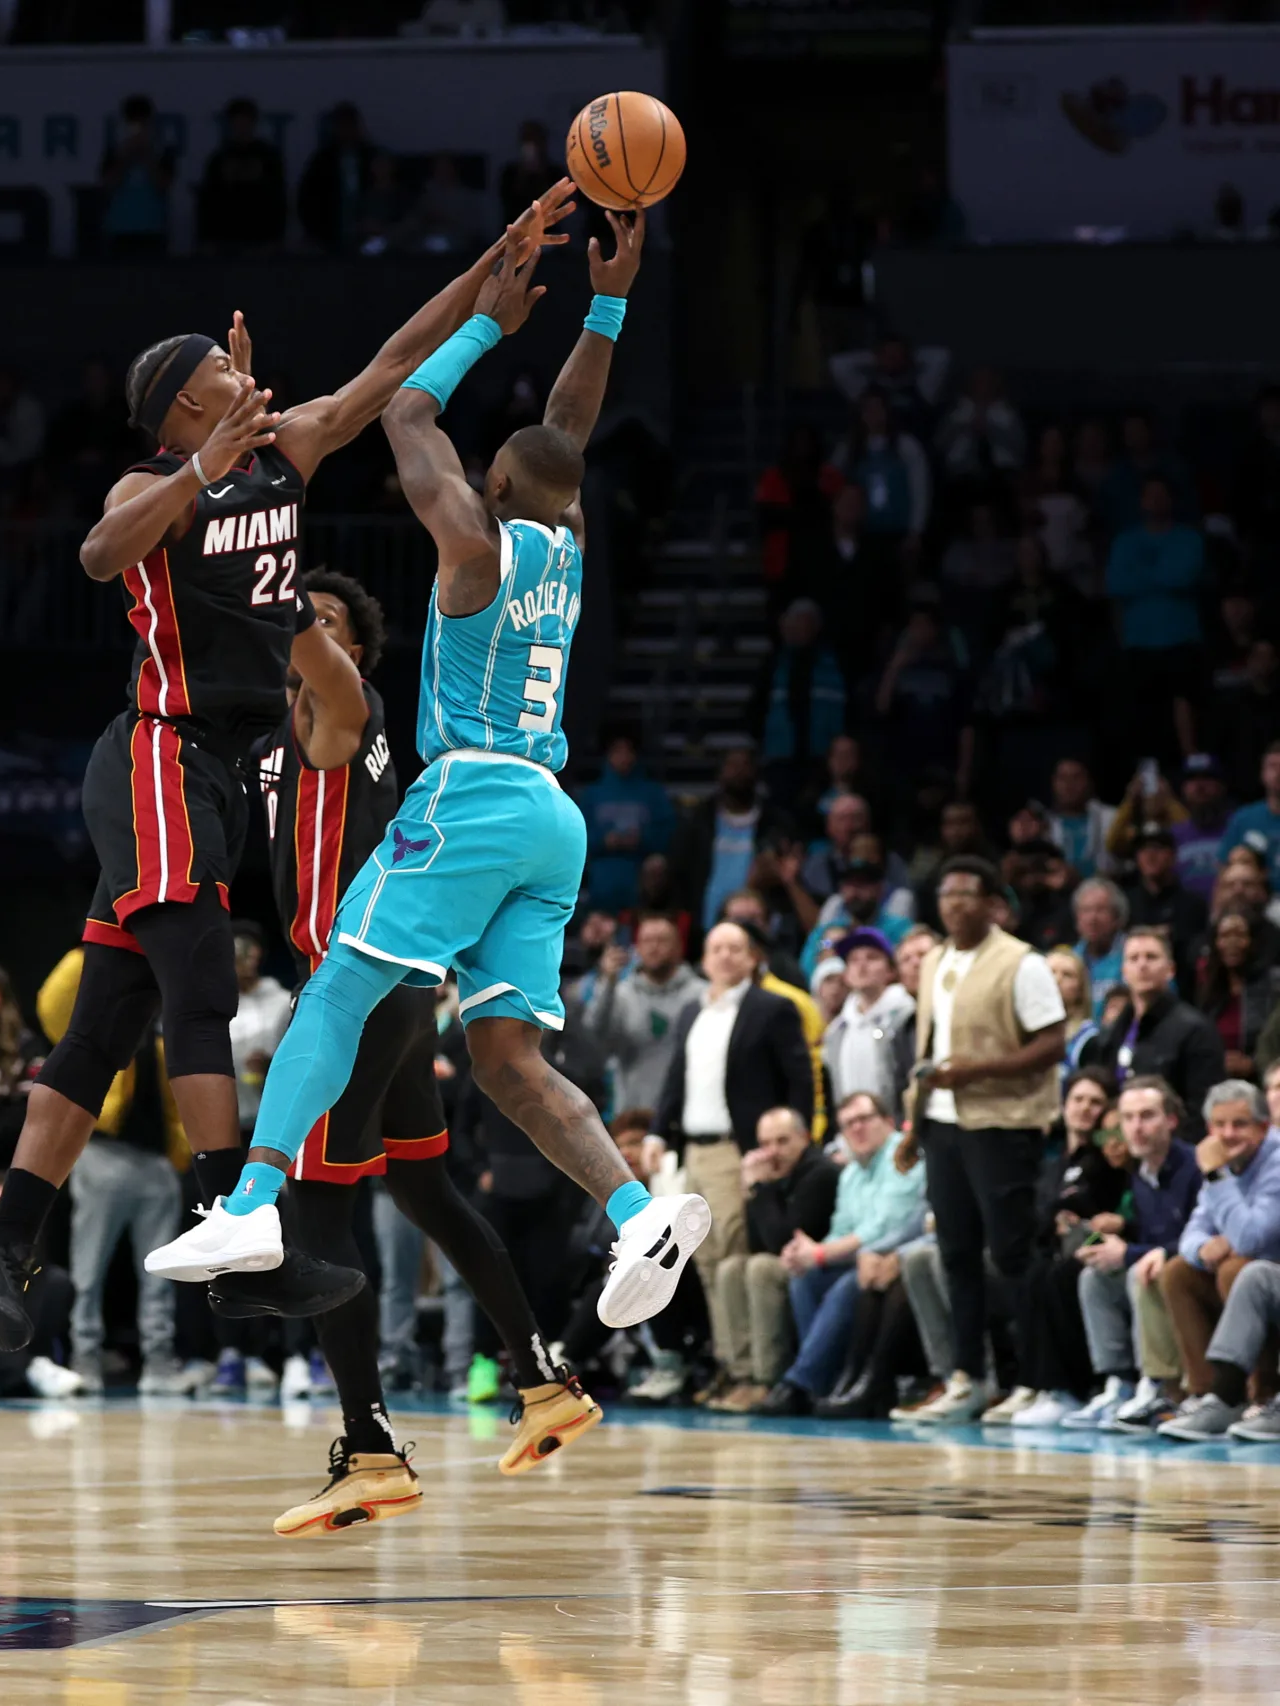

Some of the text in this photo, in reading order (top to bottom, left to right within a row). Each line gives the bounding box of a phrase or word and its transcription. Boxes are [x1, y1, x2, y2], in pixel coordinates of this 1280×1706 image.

[589, 97, 612, 168] Wilson
[201, 501, 299, 556] MIAMI
[250, 548, 297, 607] 22
[507, 580, 568, 632] ROZIER
[517, 644, 564, 733] 3
